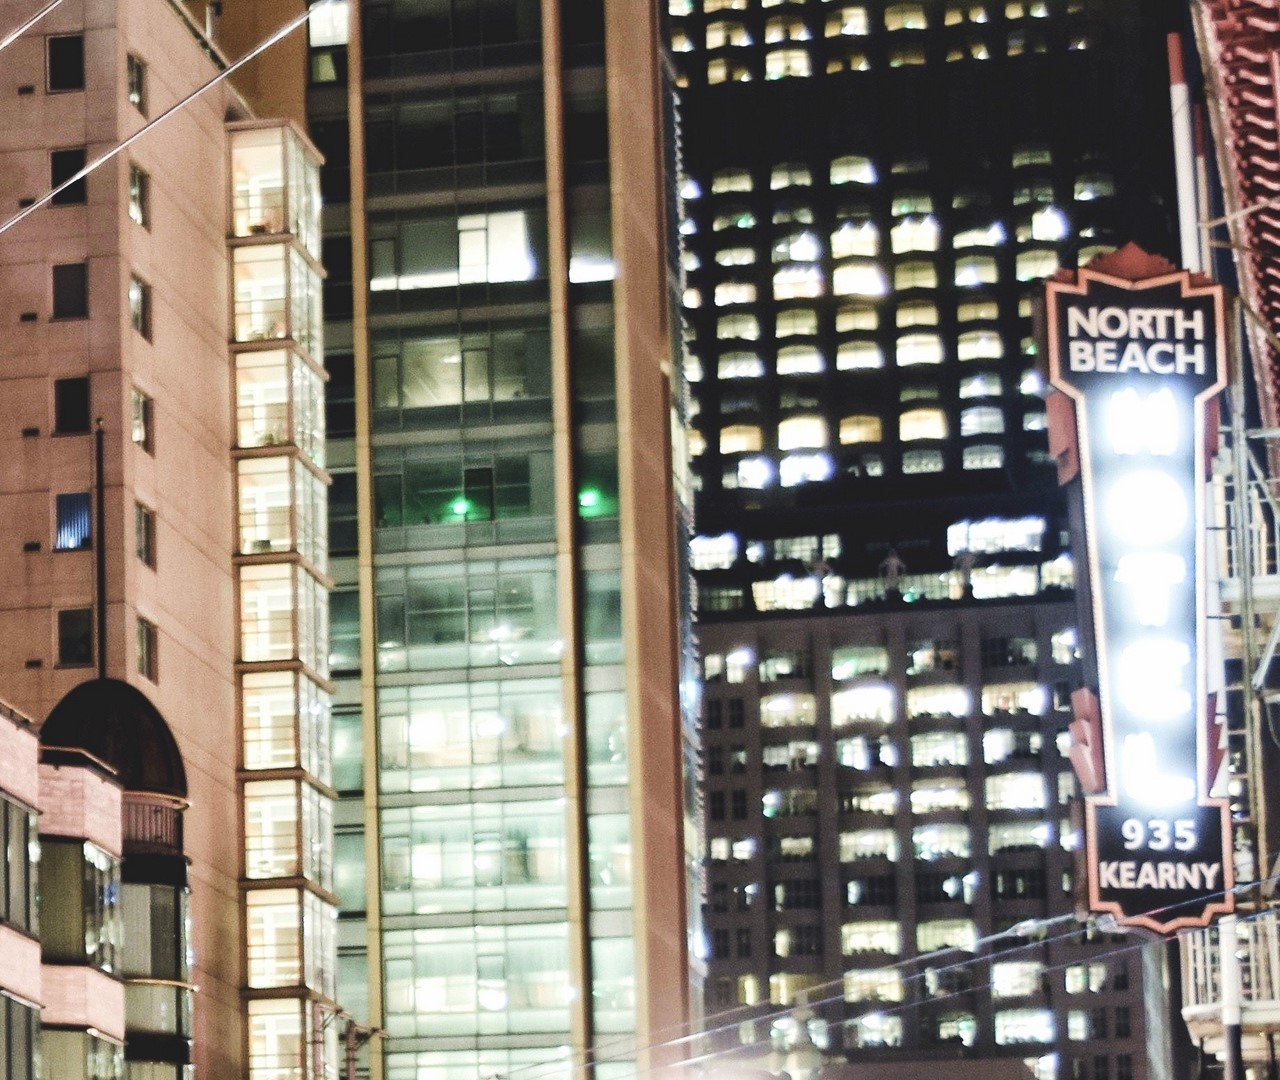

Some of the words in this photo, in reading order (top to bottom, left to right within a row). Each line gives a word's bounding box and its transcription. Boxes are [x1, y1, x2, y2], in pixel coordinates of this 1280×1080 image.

[1067, 306, 1204, 340] NORTH
[1068, 340, 1205, 375] BEACH
[1107, 389, 1196, 804] MOTEL
[1121, 818, 1197, 851] 935
[1099, 861, 1220, 890] KEARNY
